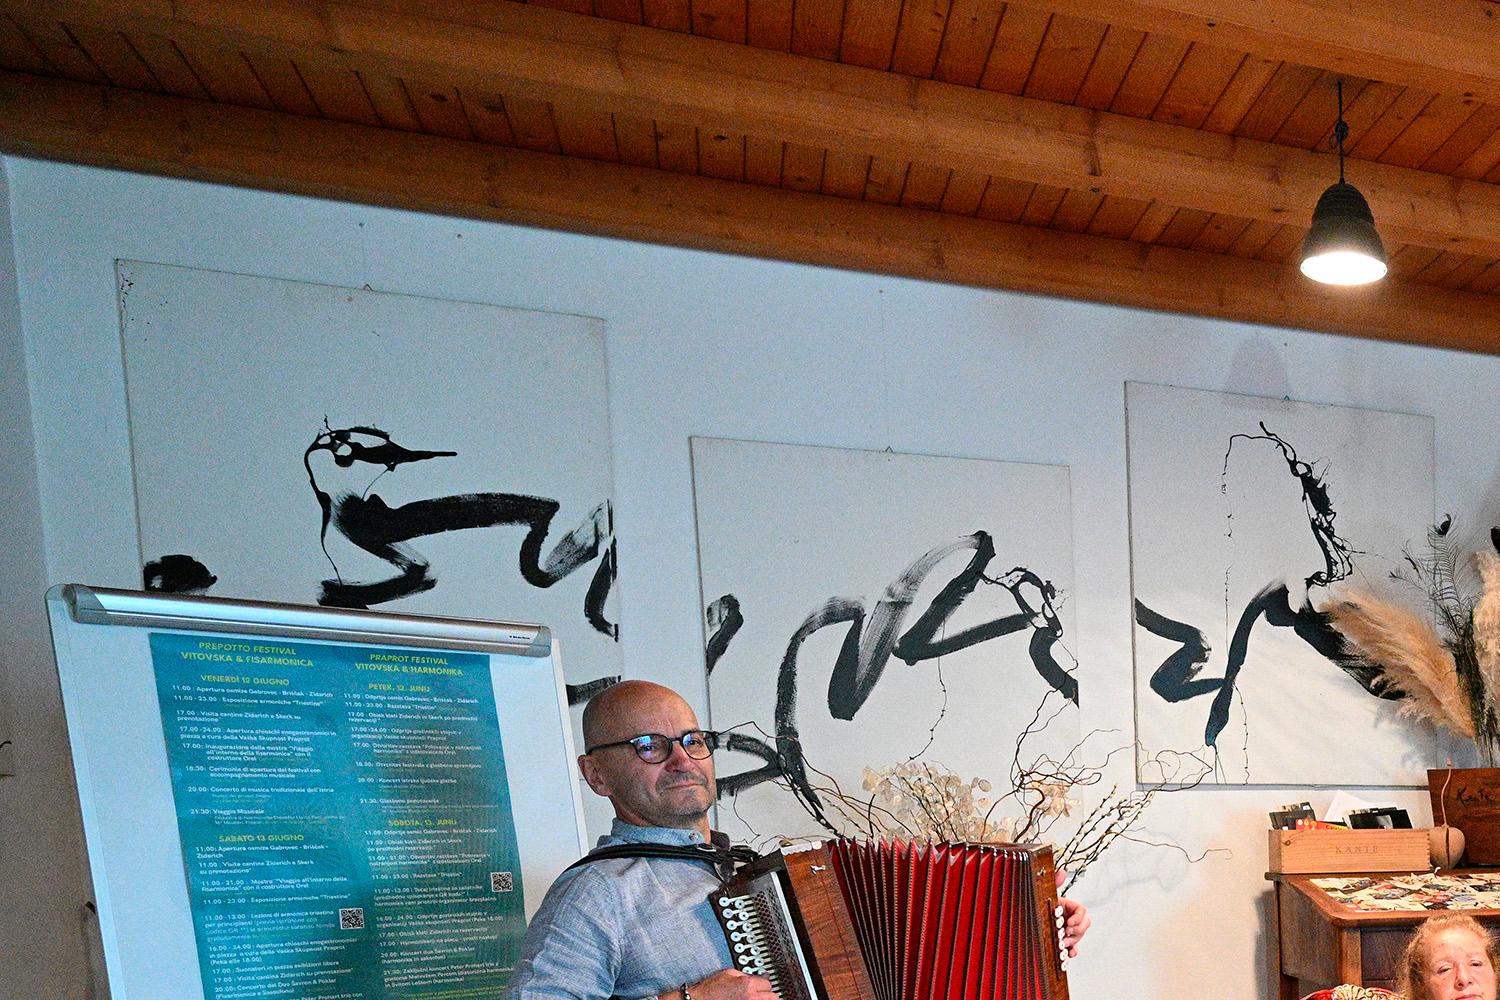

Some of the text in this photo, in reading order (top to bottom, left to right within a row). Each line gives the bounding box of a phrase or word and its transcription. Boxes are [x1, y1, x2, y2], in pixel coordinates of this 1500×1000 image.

[199, 642, 297, 656] PREPOTTO FESTIVAL
[181, 652, 314, 667] VITOVSKA & FISARMONICA
[370, 654, 448, 665] PRAPROT FESTIVAL
[355, 663, 400, 673] VITOVSKA
[410, 666, 464, 676] HARMONIKA
[253, 677, 289, 686] GIUGNO
[219, 834, 256, 842] SABATO
[268, 834, 305, 842] GIUGNO
